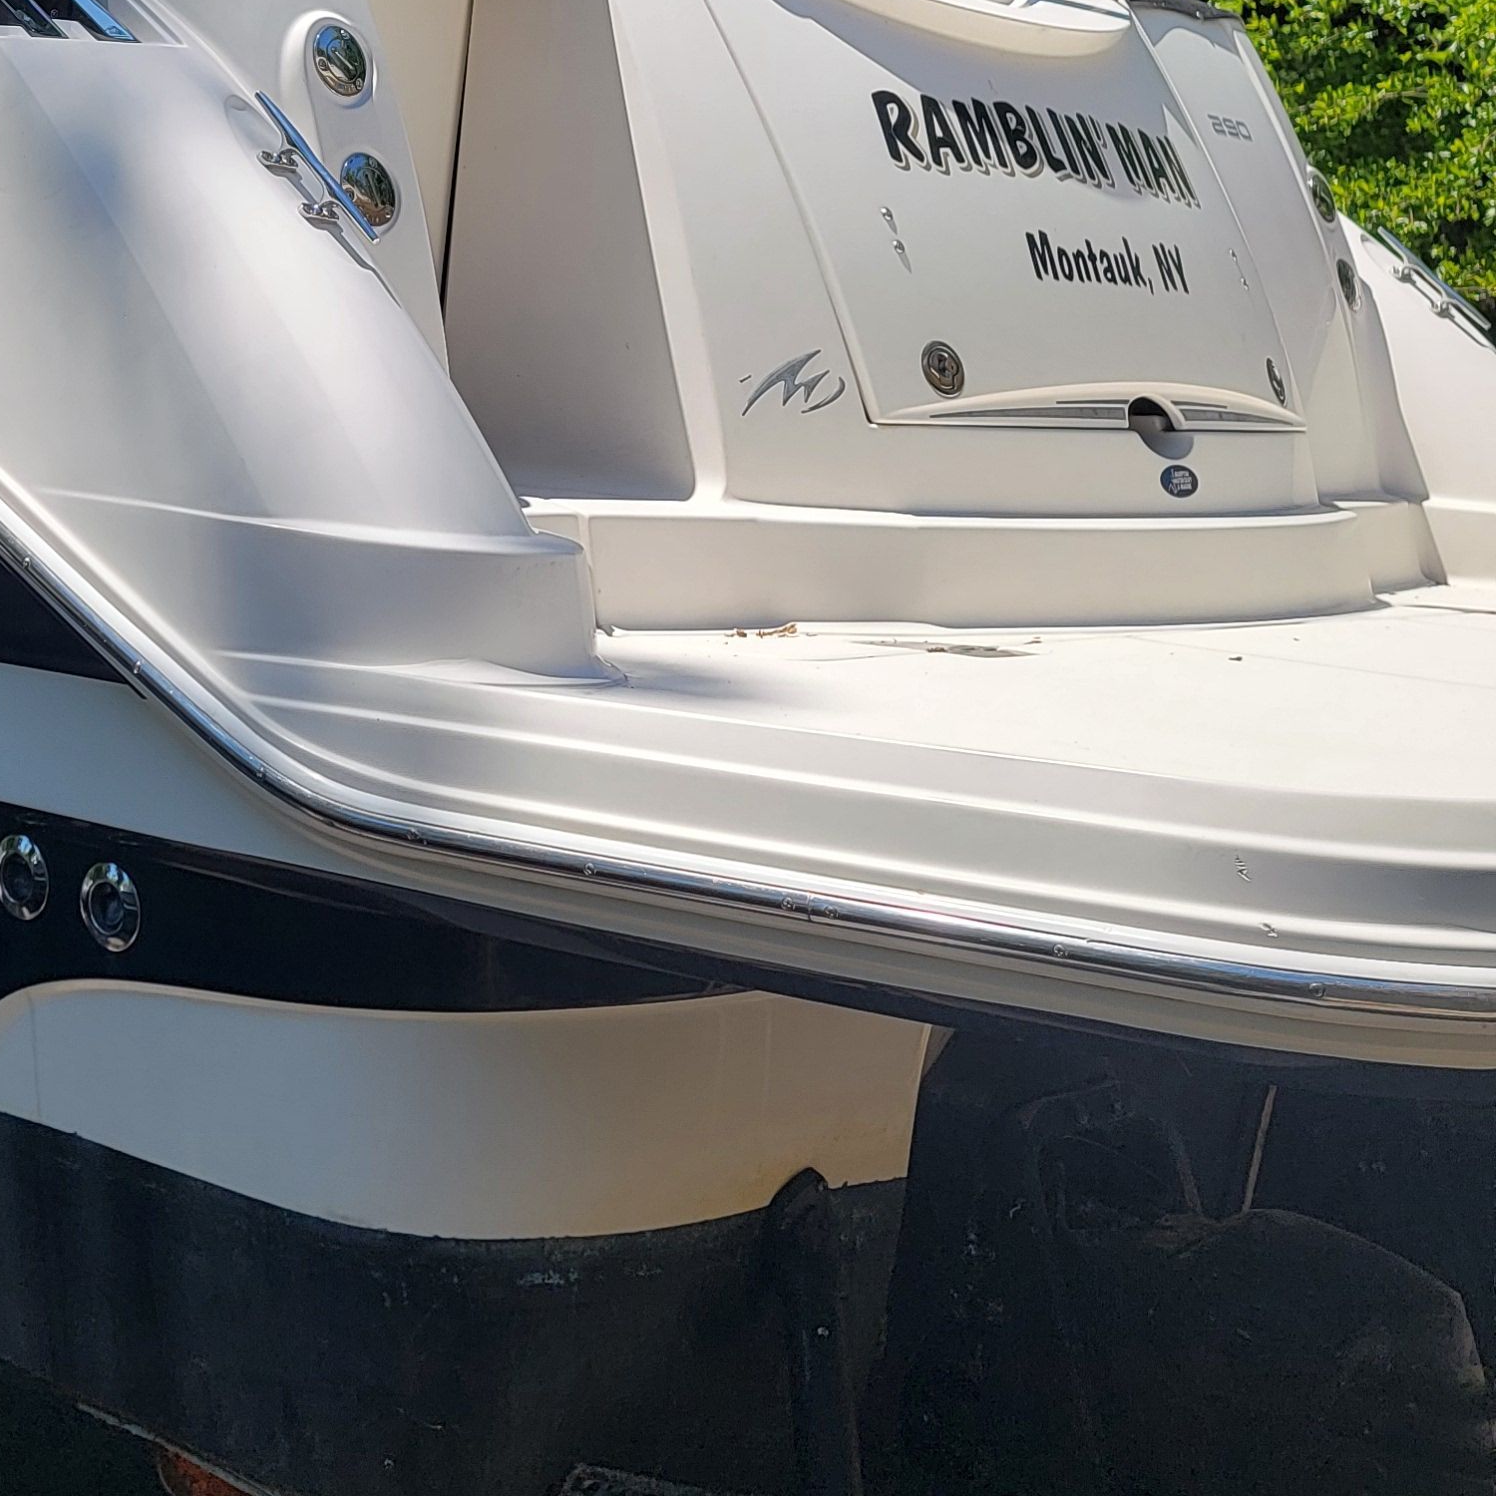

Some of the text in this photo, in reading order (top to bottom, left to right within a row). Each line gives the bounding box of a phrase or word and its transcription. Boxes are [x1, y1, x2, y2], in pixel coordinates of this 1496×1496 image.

[870, 89, 1202, 210] RAMBLIN' MAN
[1207, 113, 1253, 142] 290
[1025, 229, 1190, 295] Montauk, NY
